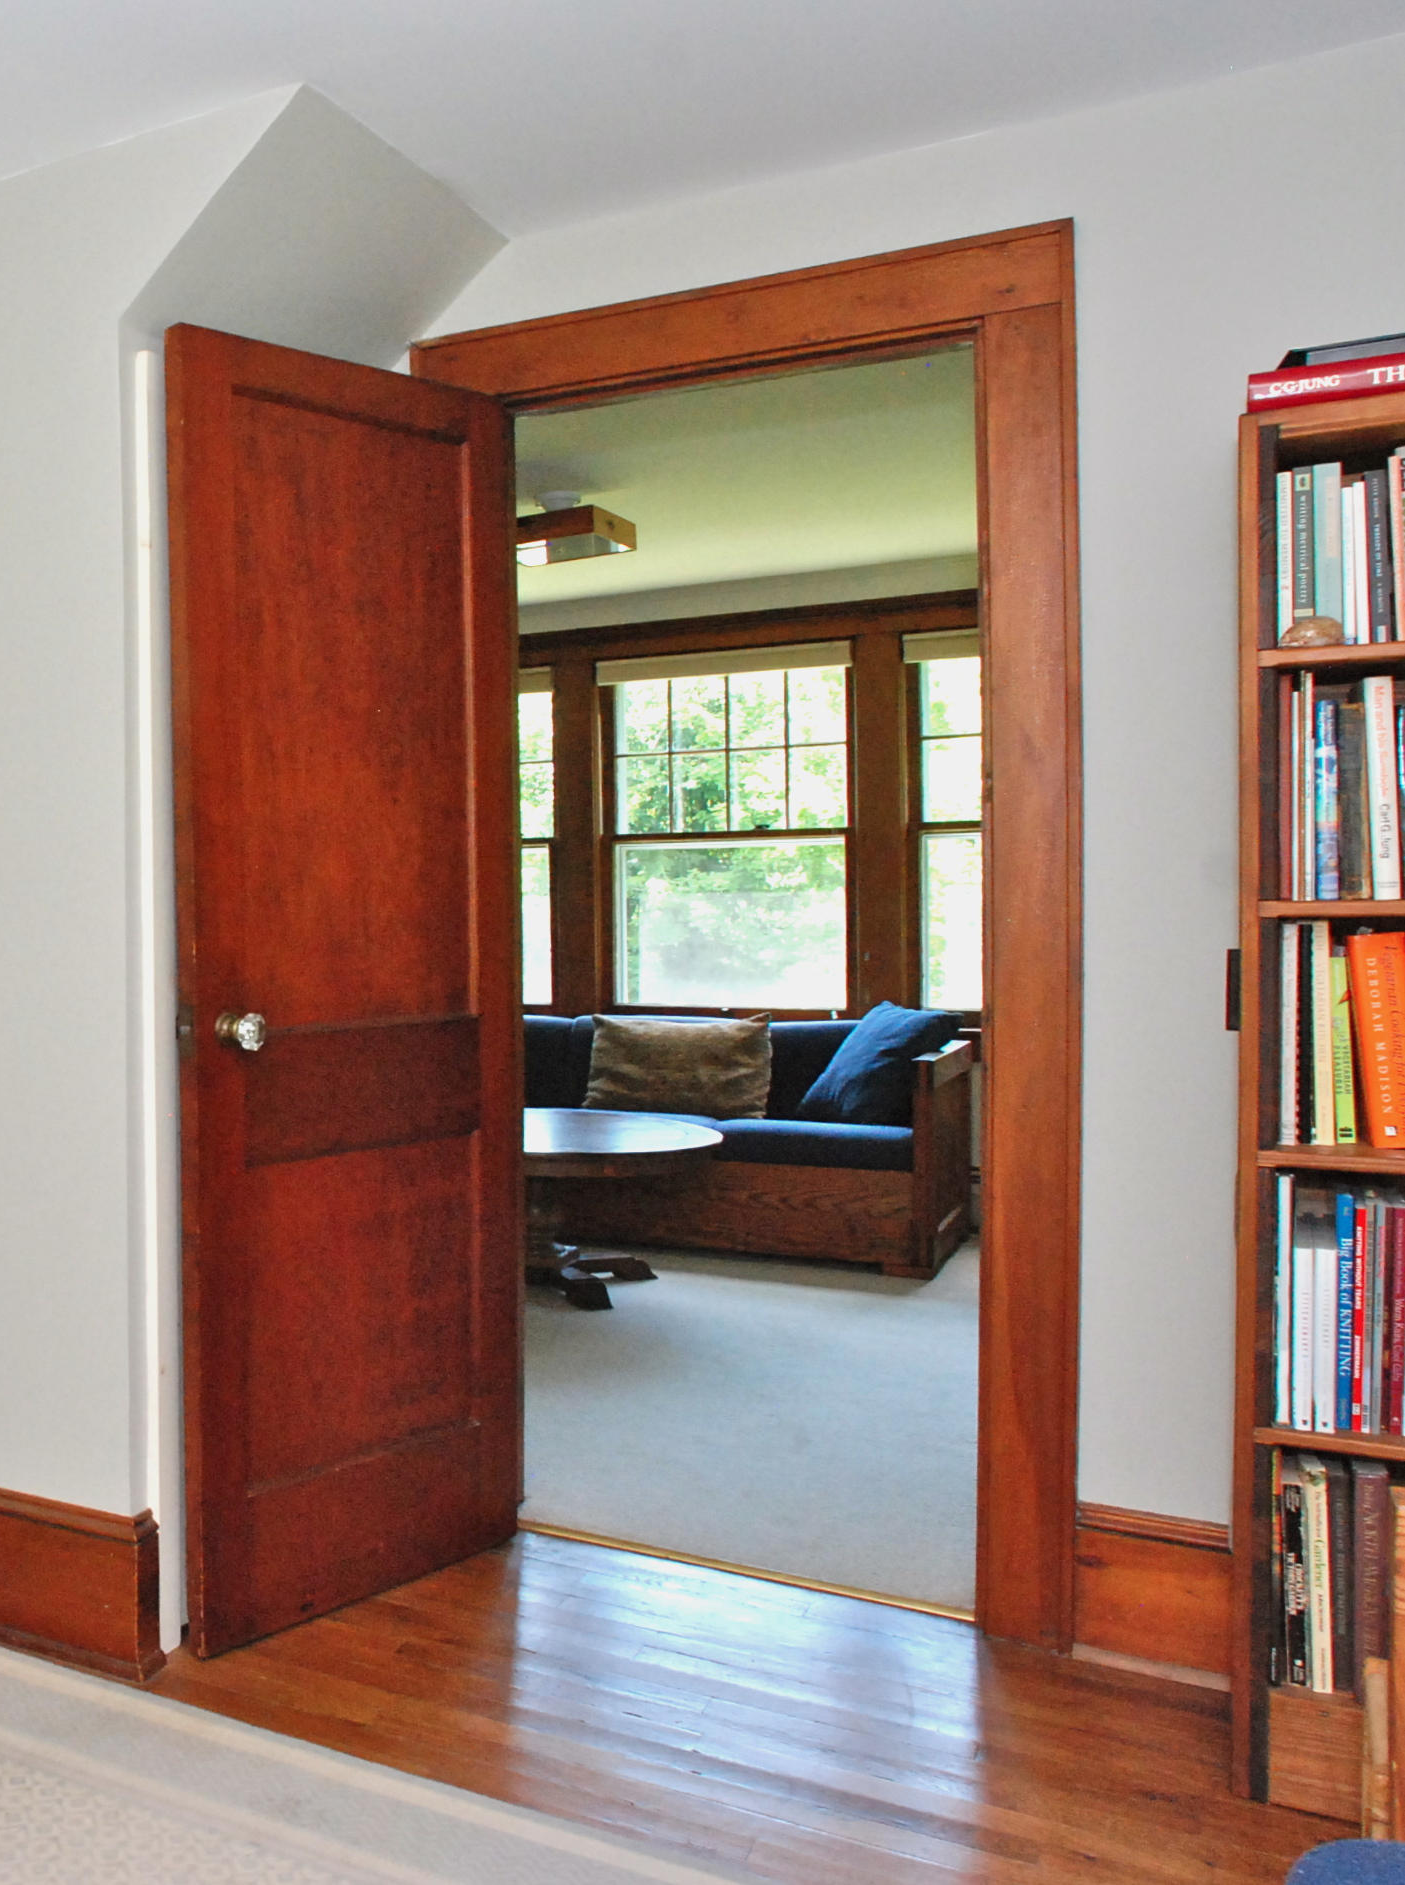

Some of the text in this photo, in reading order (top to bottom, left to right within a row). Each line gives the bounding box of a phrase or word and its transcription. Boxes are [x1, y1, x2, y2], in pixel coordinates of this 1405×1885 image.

[1297, 495, 1309, 604] writing metrical poetry
[1373, 686, 1386, 708] Man
[1375, 711, 1386, 731] and
[1377, 733, 1388, 749] his
[1379, 804, 1390, 823] Carl
[1378, 836, 1391, 859] Jung
[1366, 958, 1393, 1115] DEBORAH MADISON
[1343, 1045, 1352, 1095] VEGETARIAN
[1355, 1226, 1363, 1256] KNITTING
[1355, 1258, 1363, 1287] WITHOUT
[1337, 1237, 1353, 1377] Big Book of KNITTING
[1354, 1288, 1363, 1310] TEARS
[1313, 1539, 1325, 1589] Gardener
